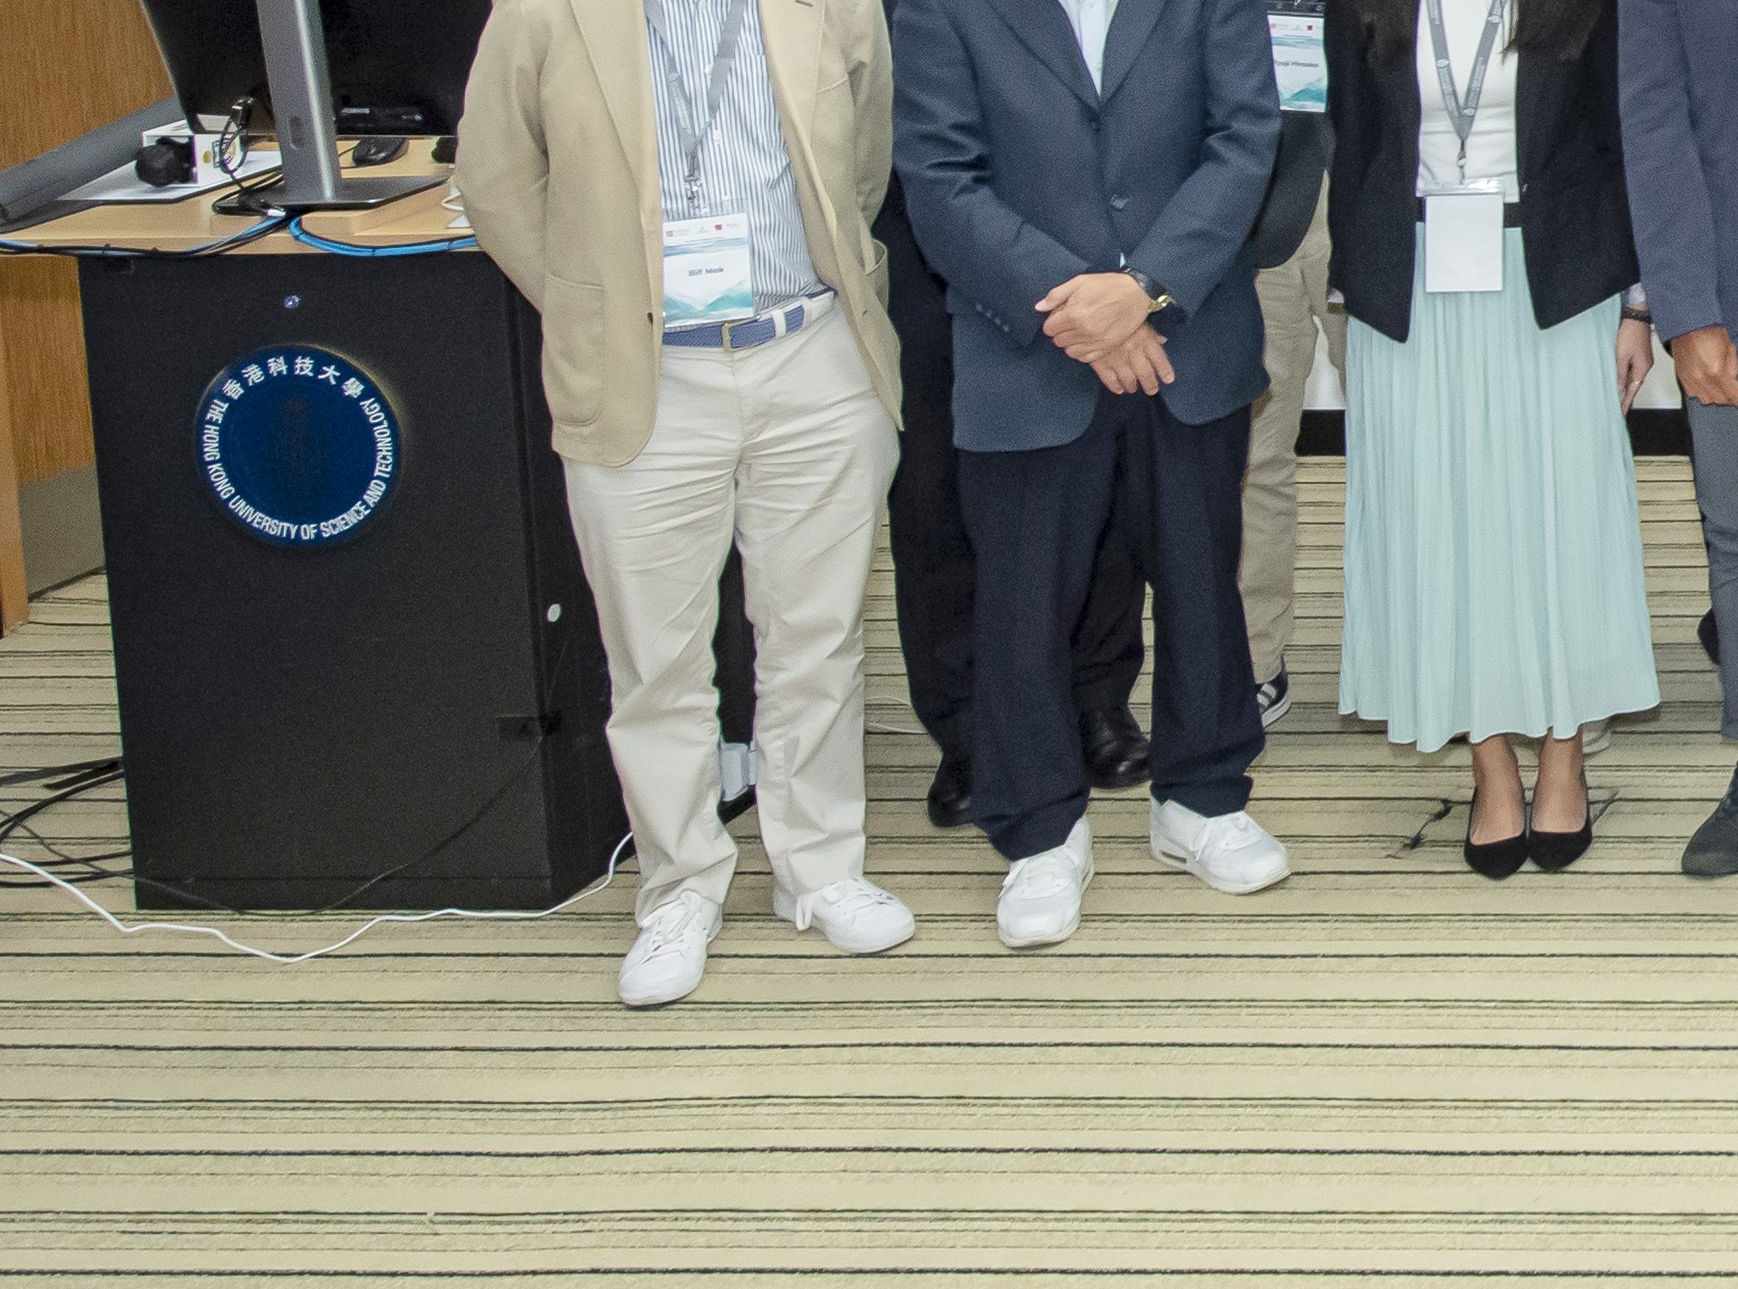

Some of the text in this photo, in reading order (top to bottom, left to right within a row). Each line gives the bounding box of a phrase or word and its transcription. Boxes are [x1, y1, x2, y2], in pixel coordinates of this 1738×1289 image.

[222, 355, 365, 400] 香港科技大學
[202, 397, 394, 540] THE HONG KONG UNIVERSITY OF SCIENCE AND TECHNOLOGY
